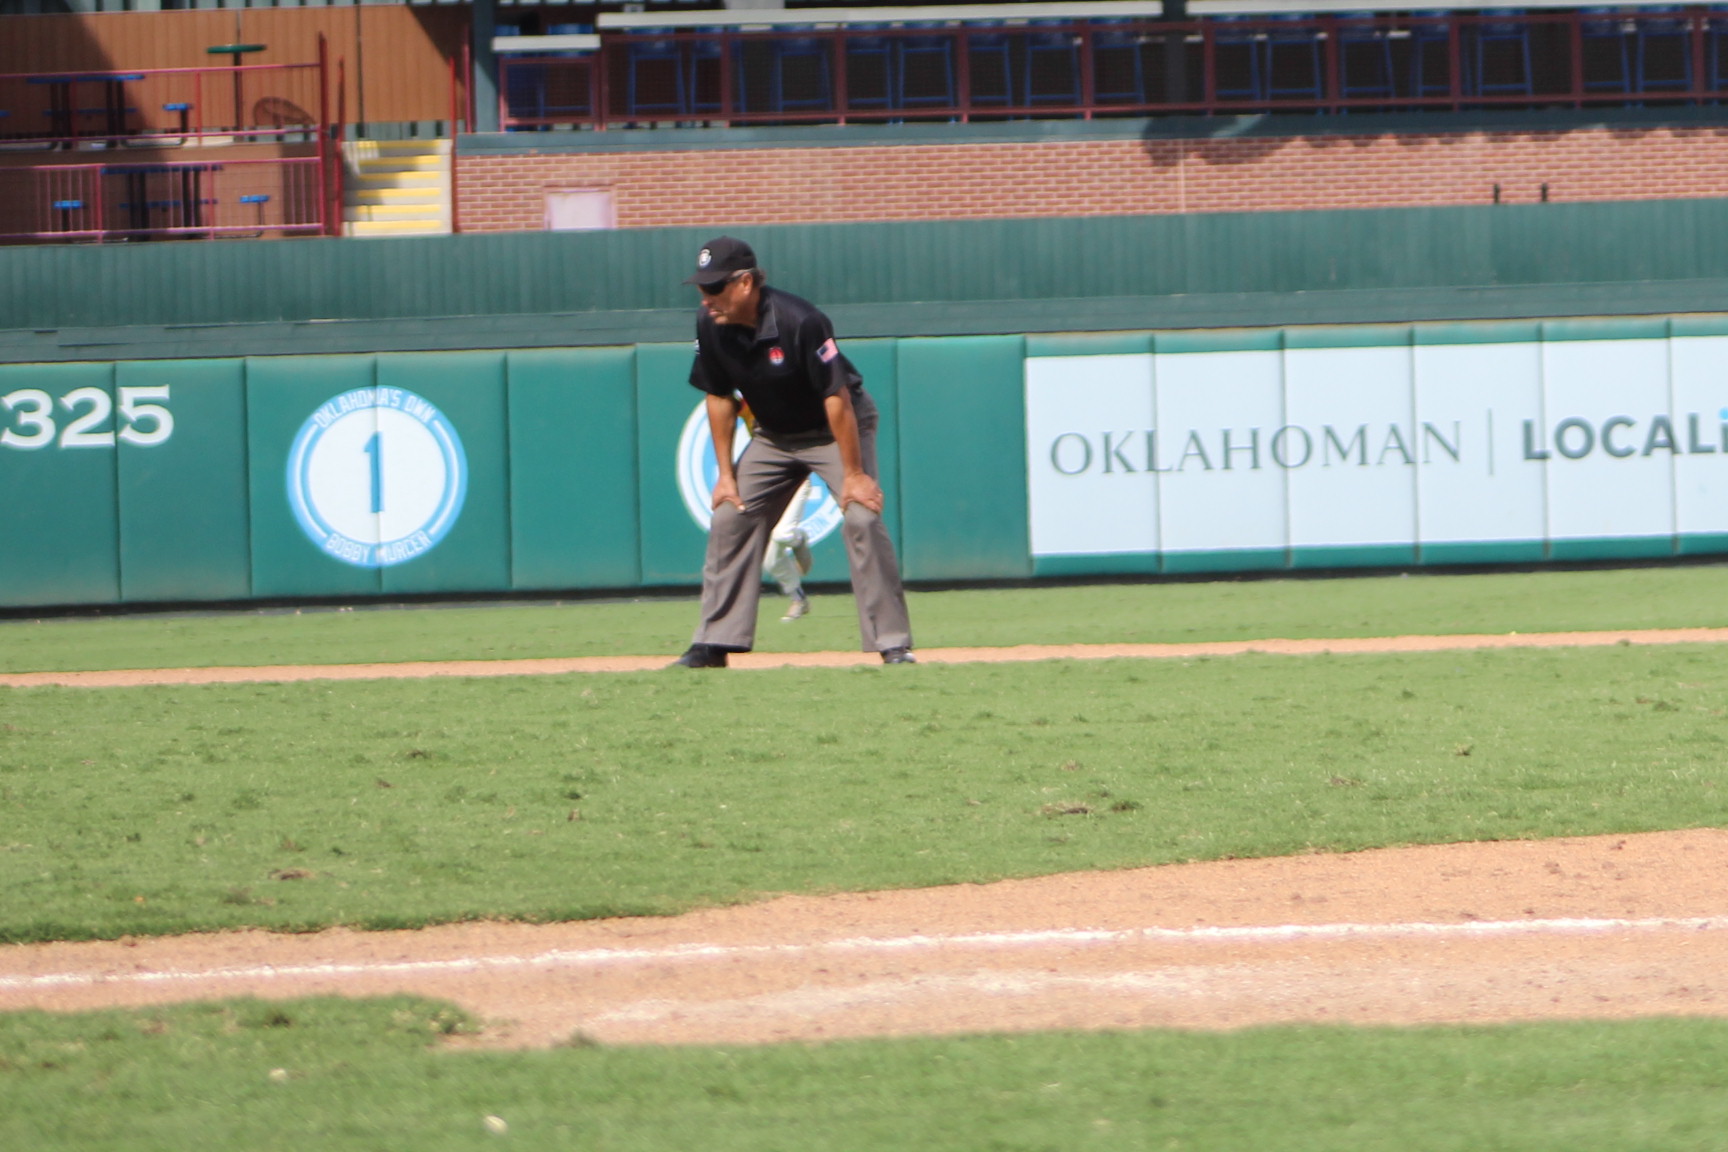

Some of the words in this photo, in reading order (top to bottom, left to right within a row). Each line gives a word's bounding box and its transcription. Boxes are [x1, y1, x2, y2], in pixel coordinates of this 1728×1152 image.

[0, 384, 175, 450] 325
[313, 388, 403, 428] OKLAHOMA'S
[403, 395, 436, 423] OWN
[363, 430, 386, 514] 1
[1050, 420, 1461, 476] OKLAHOMAN
[326, 532, 371, 563] BOBBY
